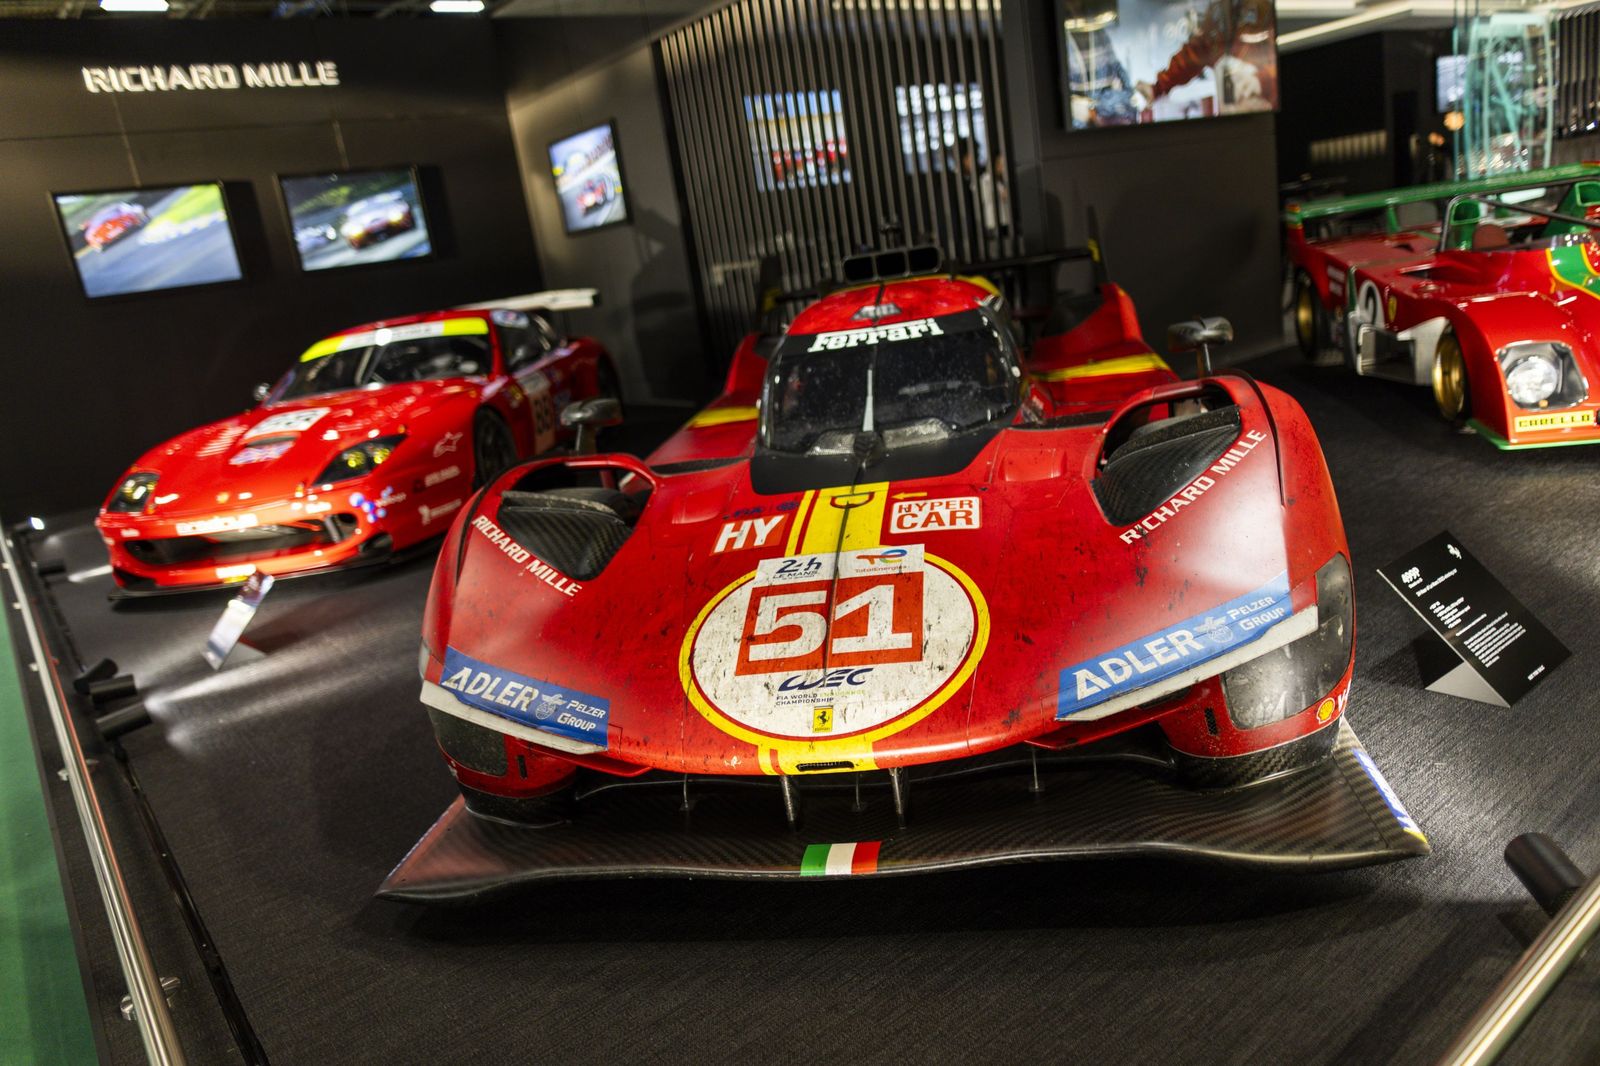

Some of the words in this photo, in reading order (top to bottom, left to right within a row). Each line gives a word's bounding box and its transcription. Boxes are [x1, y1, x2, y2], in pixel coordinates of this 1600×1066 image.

[81, 64, 240, 93] RICHARD
[241, 61, 340, 88] MILLE
[807, 318, 944, 353] Ferrari
[1119, 476, 1216, 544] RICHARD
[1211, 430, 1267, 475] MILLE
[898, 500, 974, 513] HYPER
[896, 510, 974, 529] CAR
[713, 515, 785, 553] HY
[472, 515, 530, 563] RICHARD
[526, 560, 582, 596] MILLE
[855, 565, 907, 573] TotalEnergis
[1227, 597, 1276, 620] PELZER
[1238, 607, 1285, 631] GROUP
[749, 585, 913, 662] 51
[1072, 629, 1205, 700] ADLER
[441, 666, 539, 712] ADLER
[778, 668, 874, 691] WEC
[566, 700, 606, 719] PELZER
[776, 697, 834, 705] CHAMPIONSHIP
[557, 712, 596, 732] GROUP
